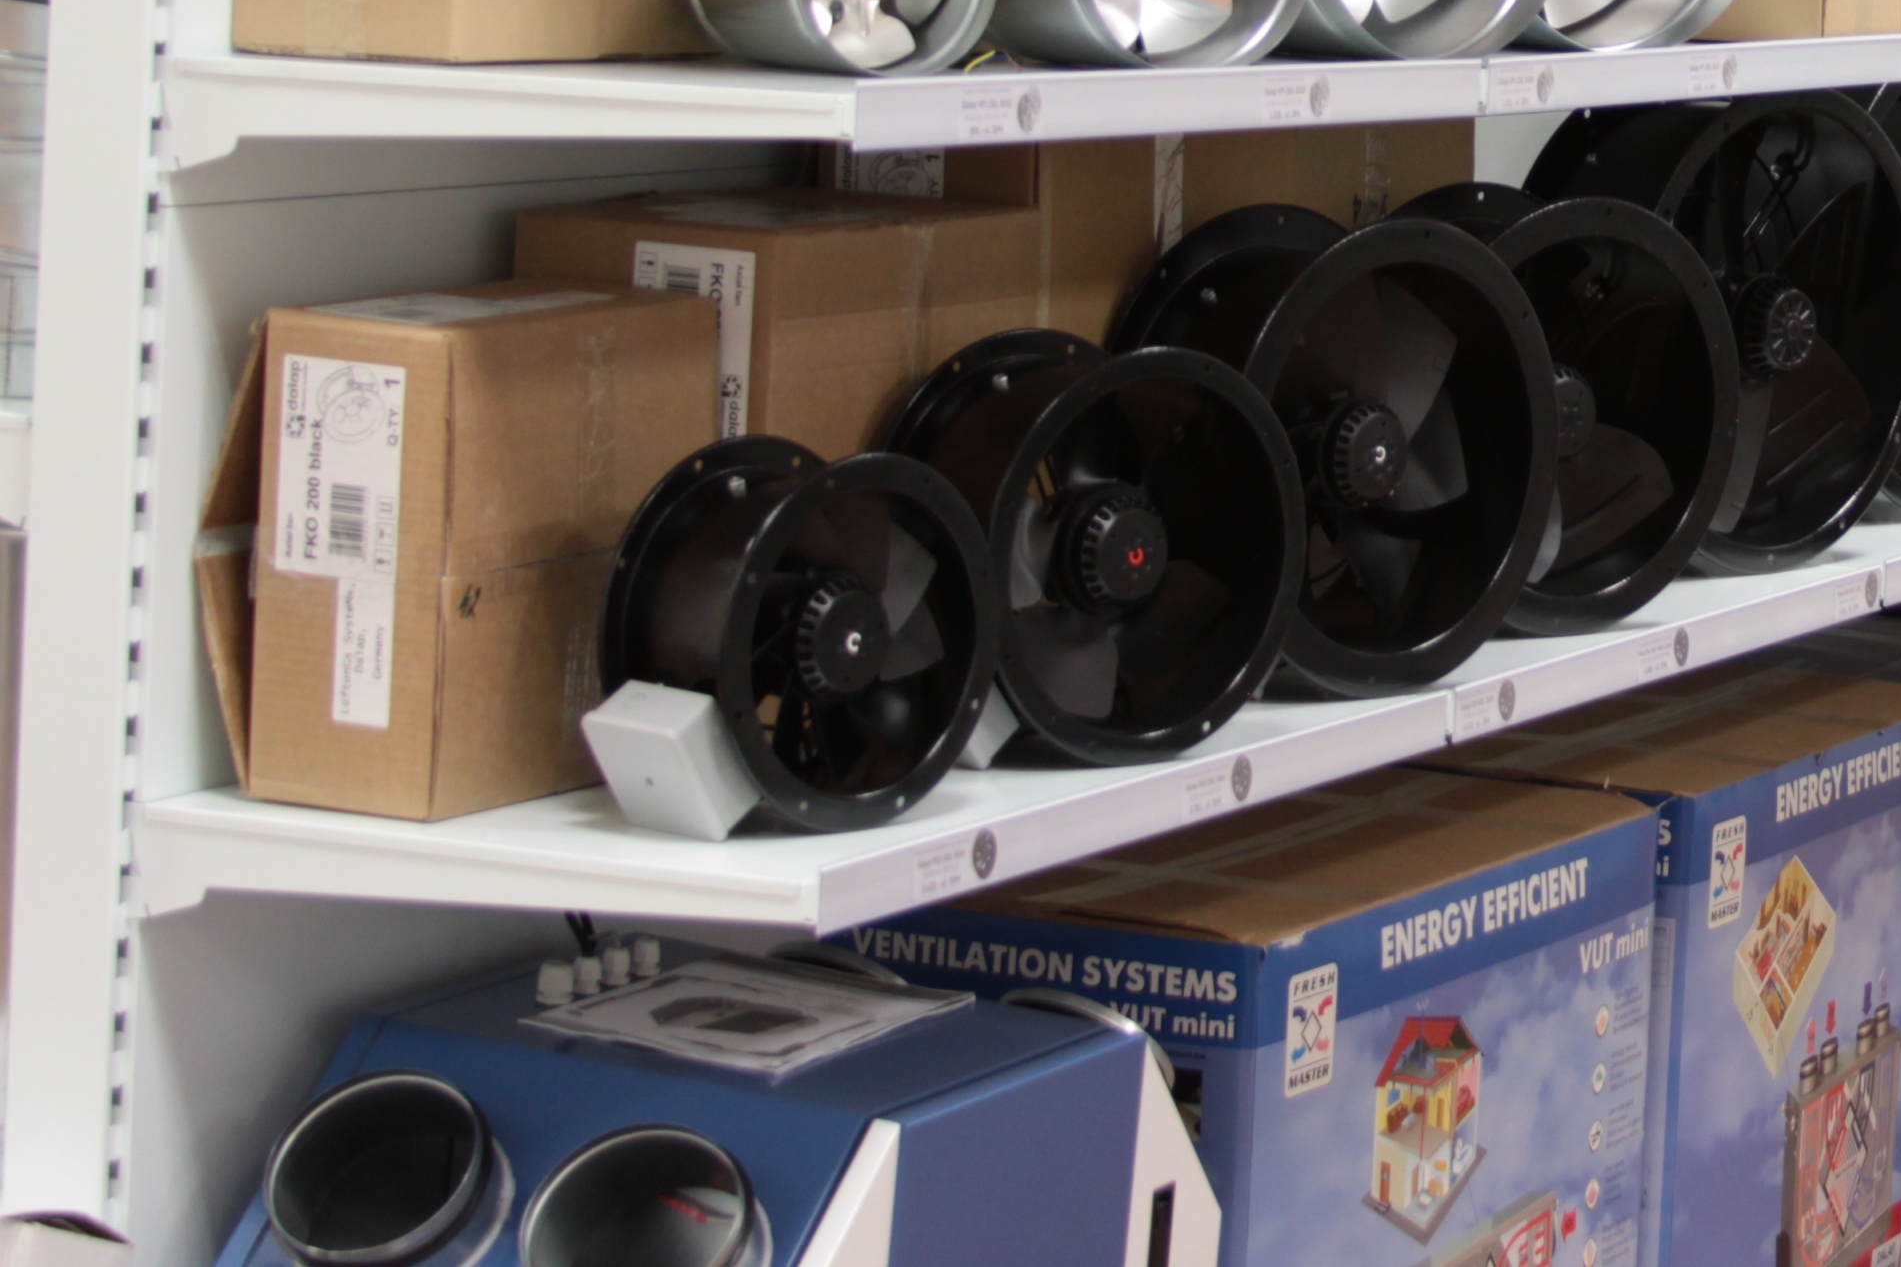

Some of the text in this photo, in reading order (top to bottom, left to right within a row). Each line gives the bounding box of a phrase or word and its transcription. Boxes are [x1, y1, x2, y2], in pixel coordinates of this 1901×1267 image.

[287, 360, 301, 411] dalap
[384, 378, 401, 389] 1
[304, 417, 324, 560] FKO 200 black
[285, 512, 294, 559] Axial fan
[373, 624, 386, 680] Germany
[1776, 763, 1844, 823] ENERGY
[1715, 821, 1746, 843] FRESH
[1380, 856, 1589, 970] ENERGY EFFICIENT
[1710, 902, 1740, 924] MASTER
[850, 926, 1239, 1004] VENTILATION SYSTEMS
[1579, 917, 1650, 974] VUT mini
[1293, 970, 1336, 996] FRESH
[1108, 1000, 1236, 1040] VUT mini
[1287, 1063, 1330, 1090] MASTER
